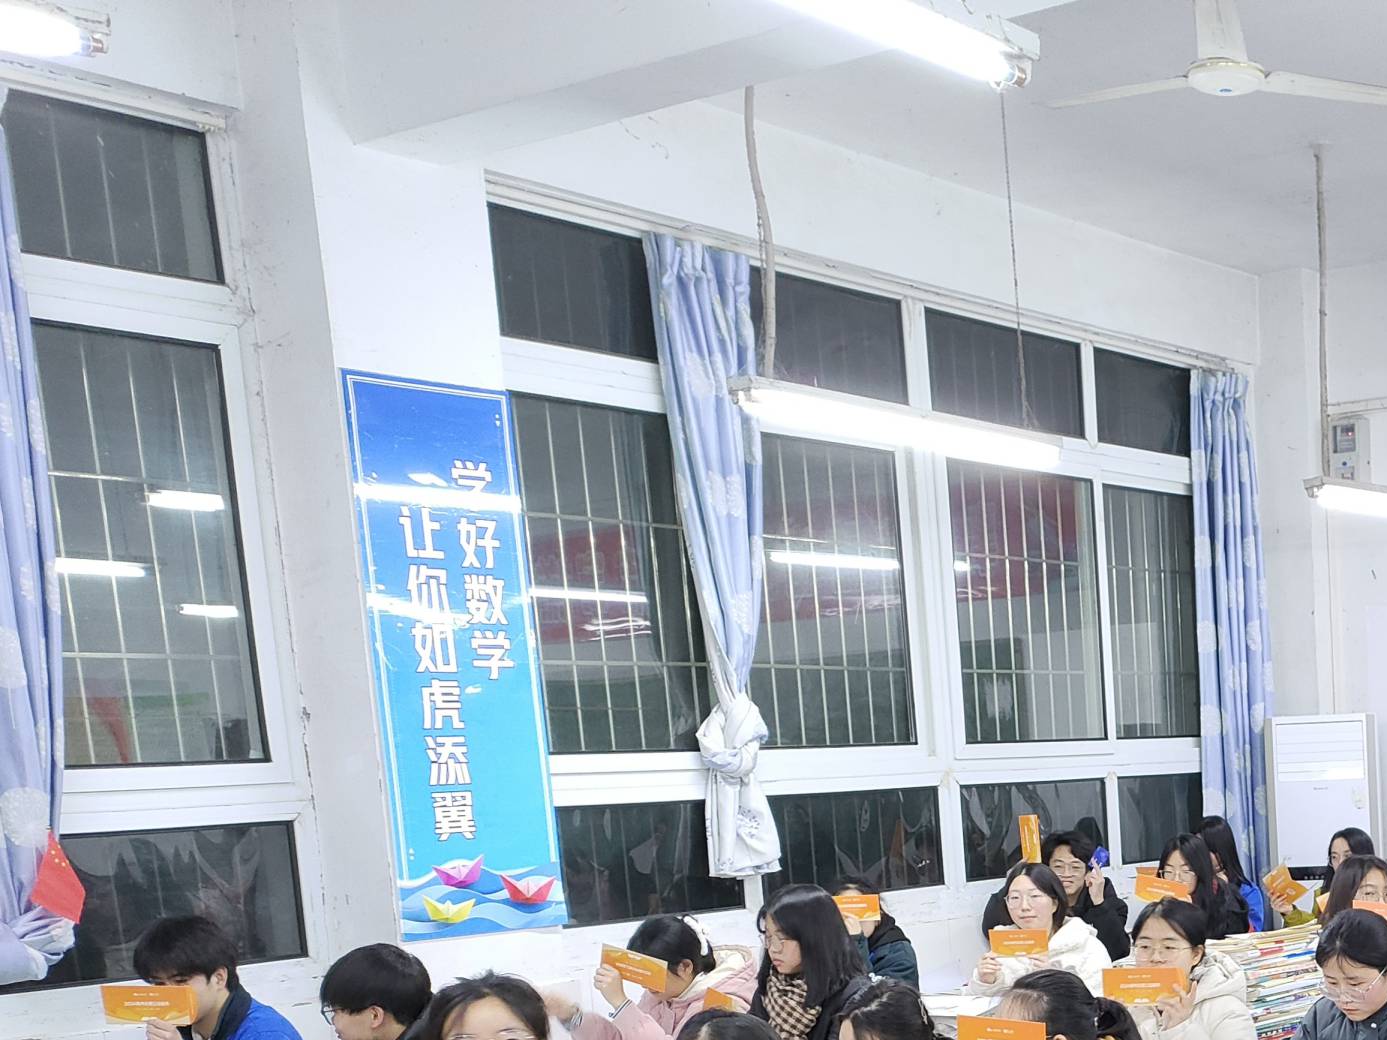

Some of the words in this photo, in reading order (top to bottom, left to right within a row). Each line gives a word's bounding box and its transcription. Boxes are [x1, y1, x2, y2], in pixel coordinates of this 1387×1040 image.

[398, 504, 478, 842] 让你如虎添翼
[451, 459, 515, 681] 学好数学
